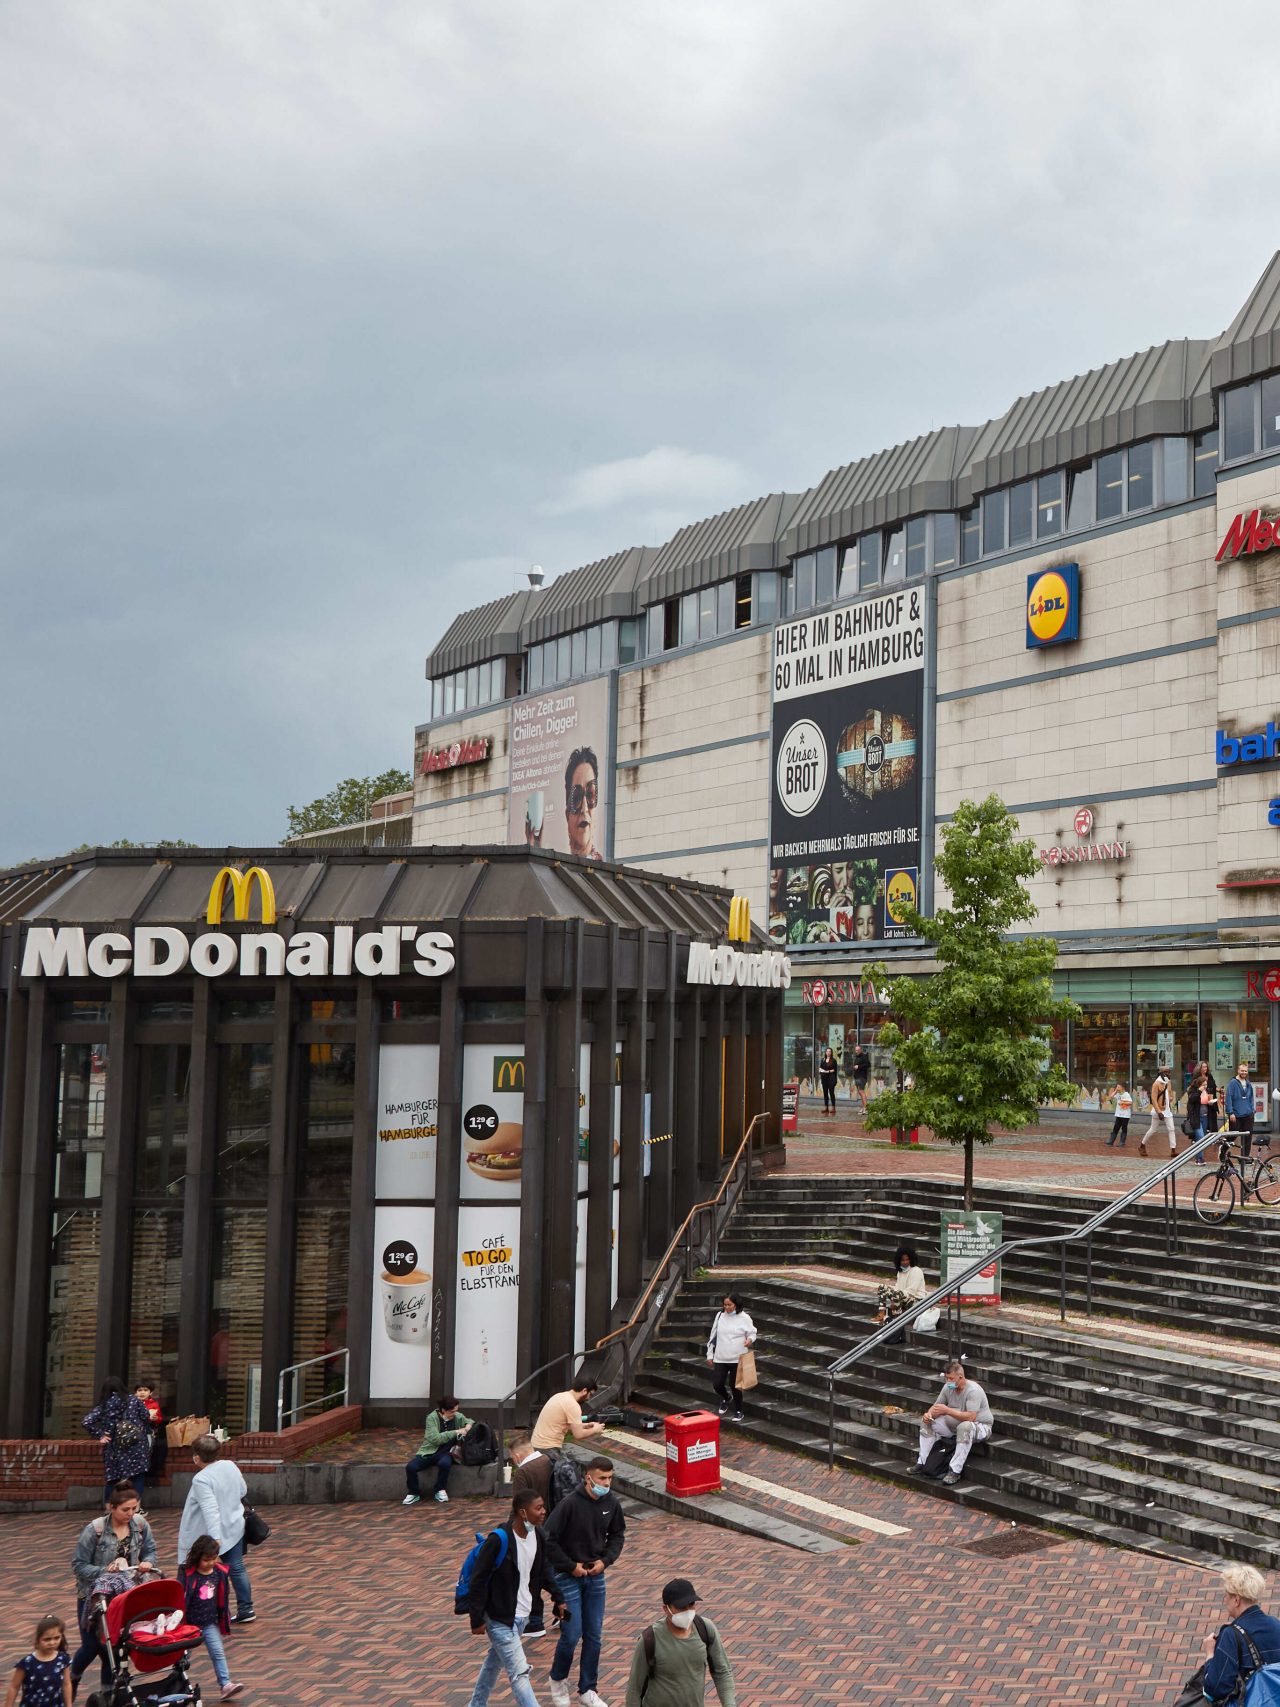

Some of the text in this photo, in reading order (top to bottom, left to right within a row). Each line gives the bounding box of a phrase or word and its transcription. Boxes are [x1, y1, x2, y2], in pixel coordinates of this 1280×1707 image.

[776, 591, 920, 657] HIER IM BAHNHOF &
[775, 627, 923, 691] 60 MAL IN HAMBURG
[514, 696, 575, 722] Mehr Zeit zum
[514, 712, 578, 741] Chillen, Digger!
[785, 746, 818, 764] Unser
[867, 751, 882, 766] BROT
[512, 771, 524, 781] IKEA
[786, 761, 818, 795] BROT
[772, 827, 920, 858] WIR BACKEN MEHRMALS TÄGLICH FRISCH FÜR SIE.
[1040, 841, 1127, 866] ROSSMANN
[884, 929, 893, 938] Lidl
[22, 926, 455, 978] McDonald's
[687, 942, 791, 989] McDonald's
[385, 1099, 438, 1115] HAMBURGER
[411, 1112, 429, 1126] FÜR
[380, 1126, 439, 1142] HAMBURGE
[482, 1234, 506, 1249] CAFÉ
[464, 1249, 507, 1266] TO GO
[480, 1264, 514, 1276] FÜR DEN
[393, 1294, 426, 1315] McCafé
